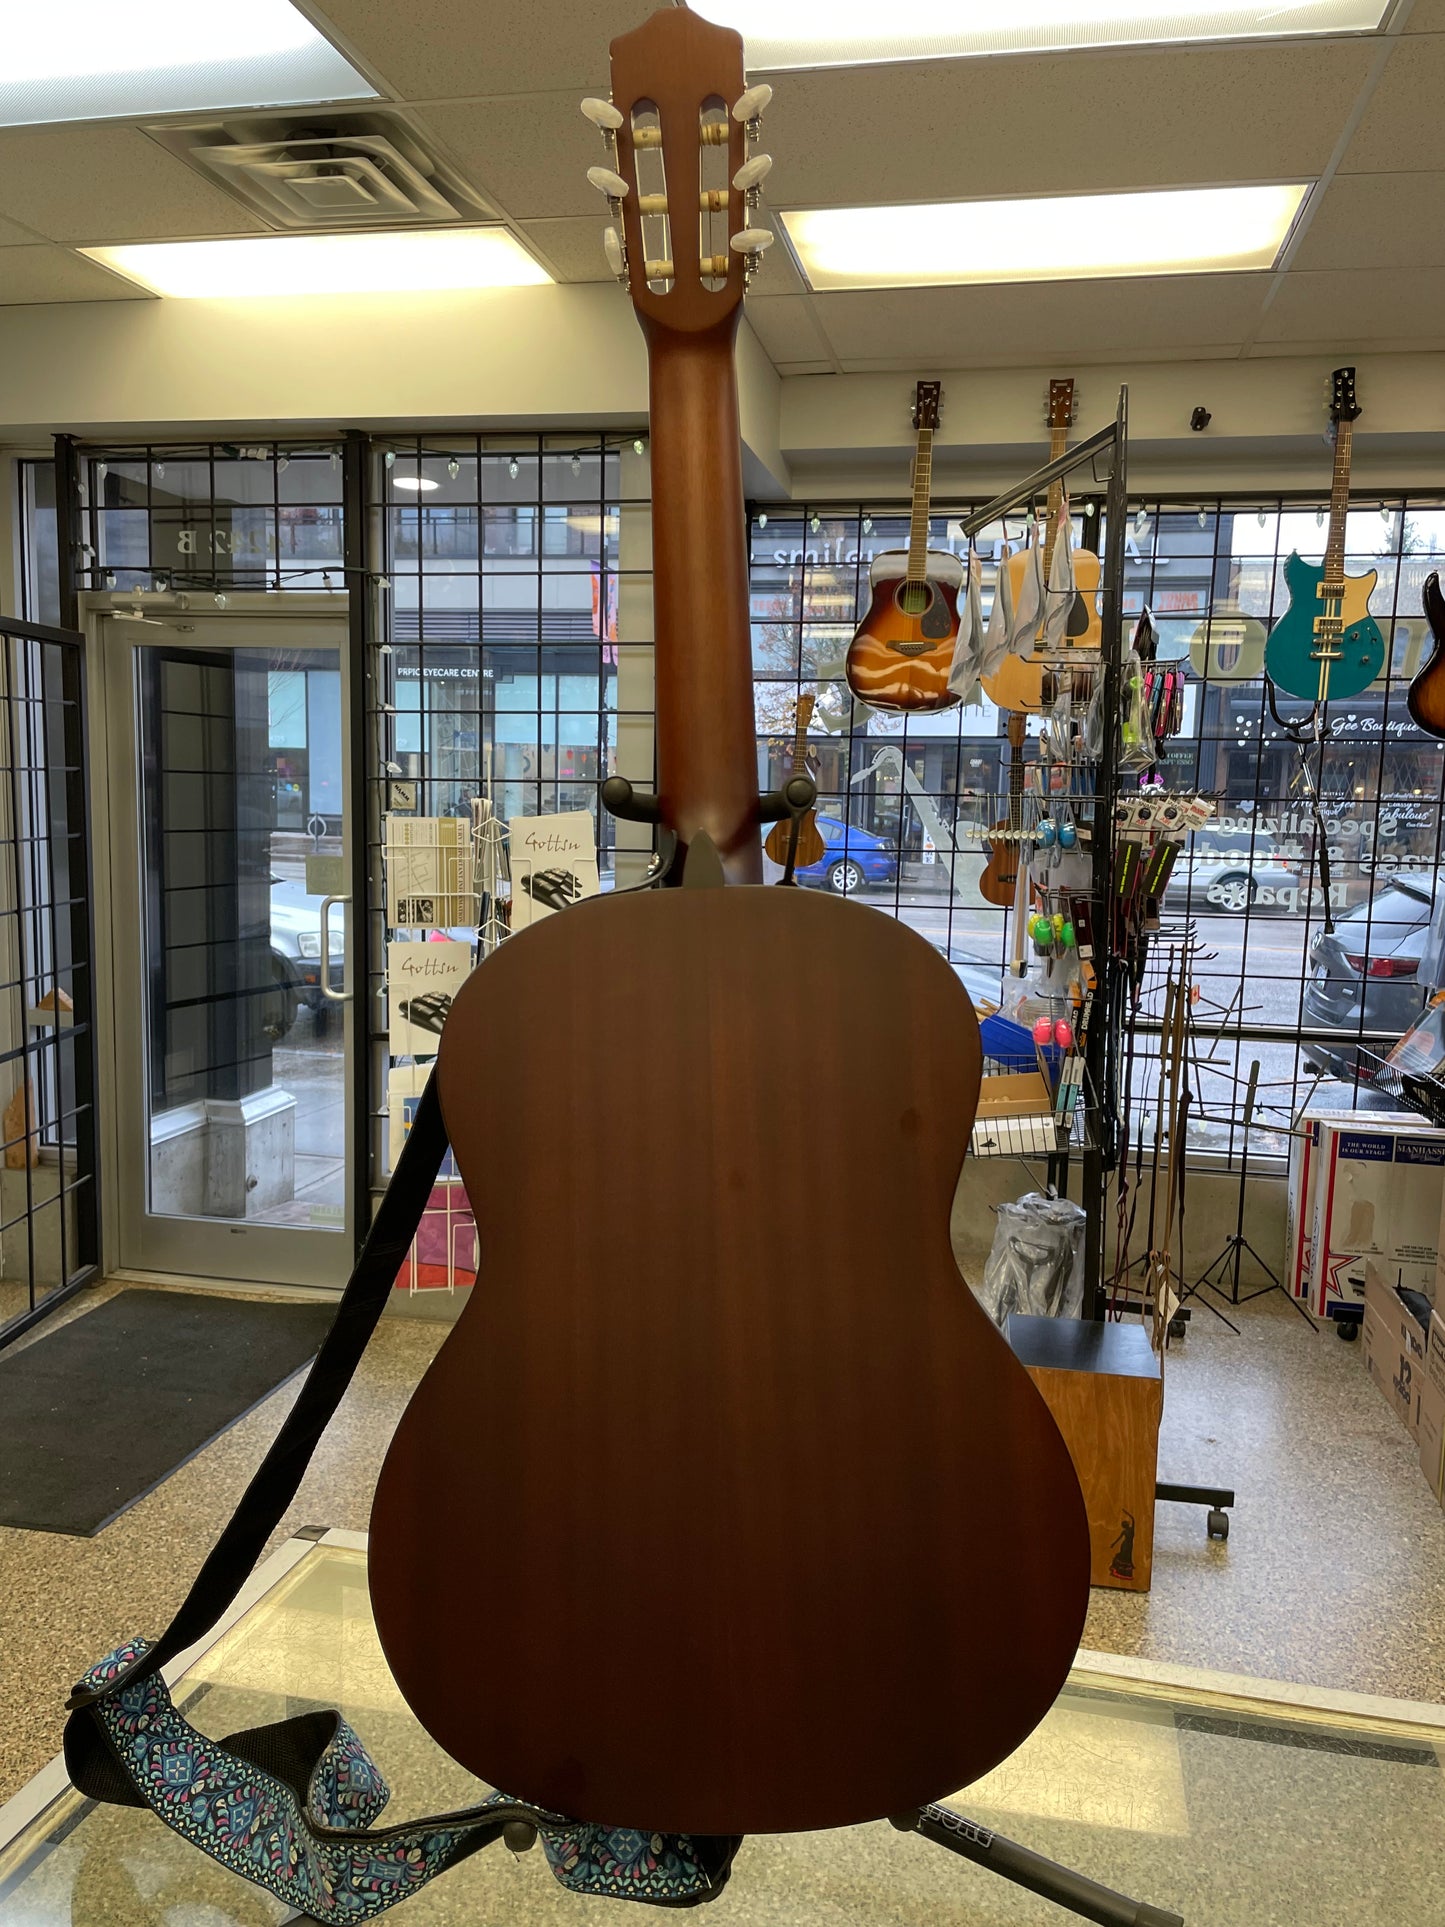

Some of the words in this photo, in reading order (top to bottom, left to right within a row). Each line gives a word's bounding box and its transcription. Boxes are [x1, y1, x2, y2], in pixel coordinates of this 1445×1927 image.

[423, 668, 460, 677] EYECARE
[1331, 716, 1358, 736] Gee
[1360, 717, 1420, 737] Boutique
[1081, 991, 1094, 1031] DRUMHEAD
